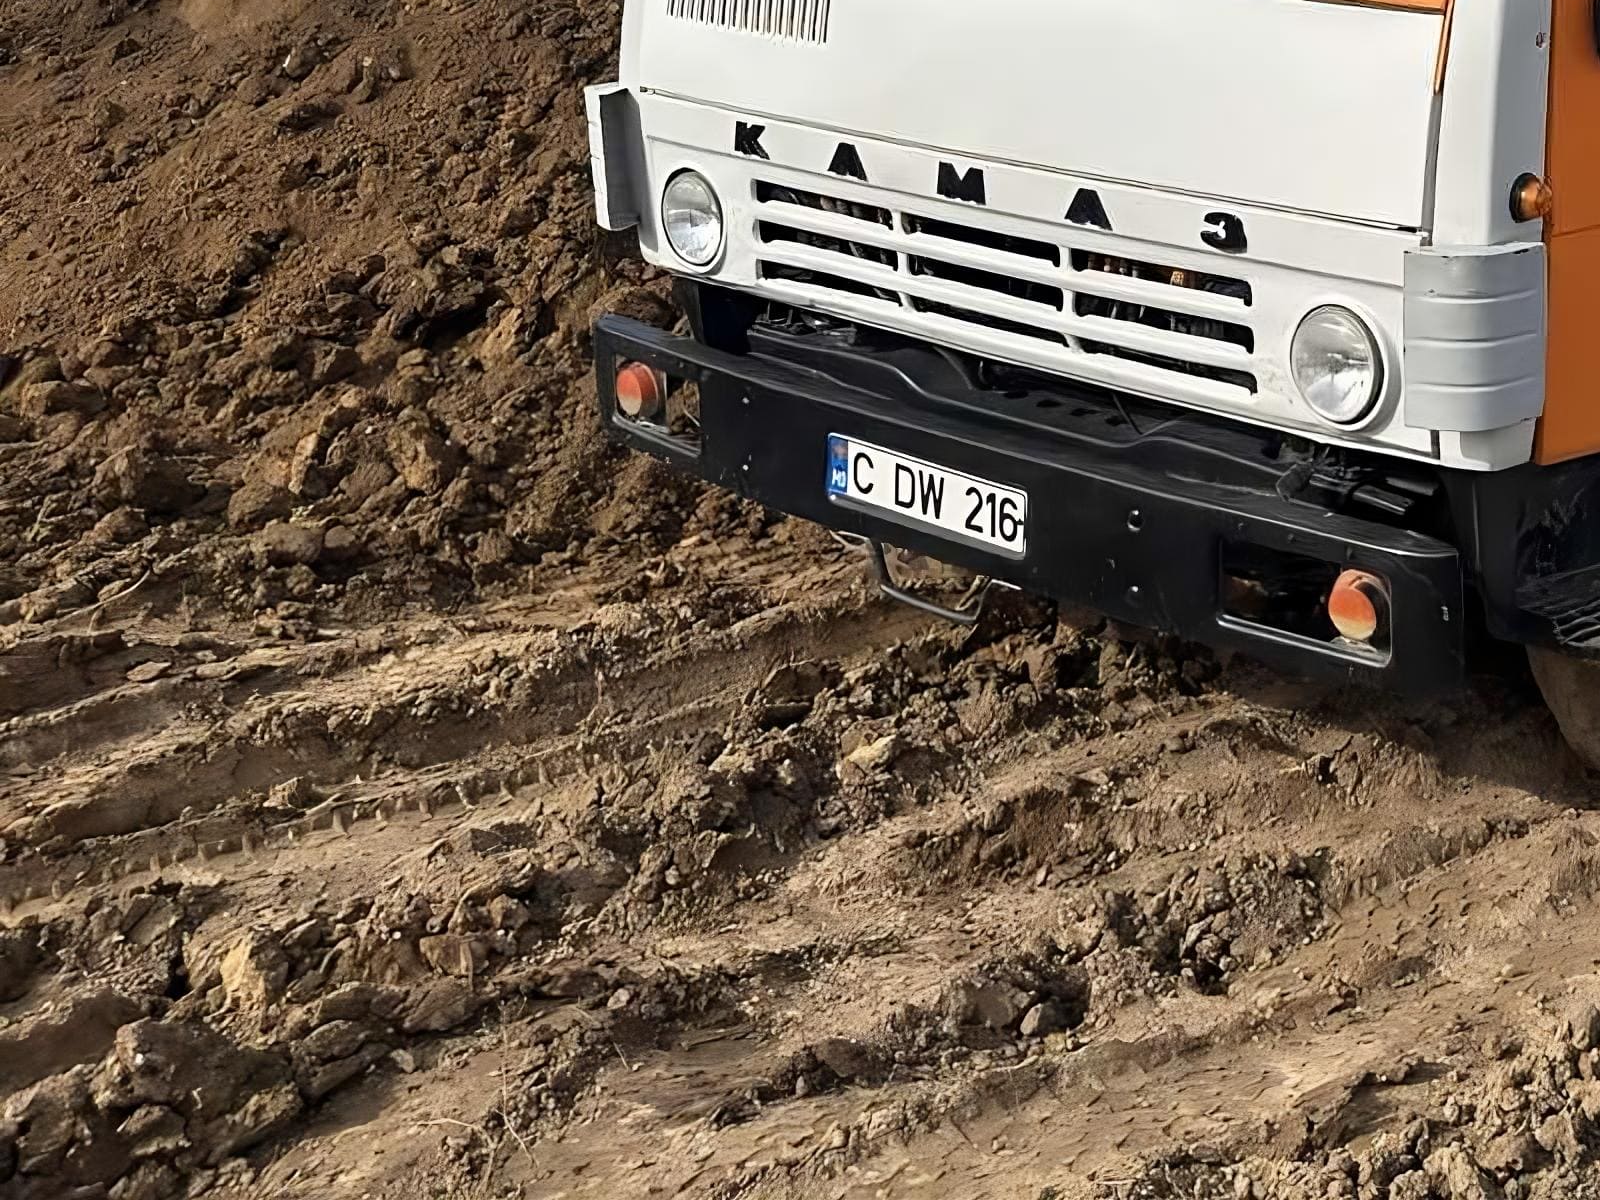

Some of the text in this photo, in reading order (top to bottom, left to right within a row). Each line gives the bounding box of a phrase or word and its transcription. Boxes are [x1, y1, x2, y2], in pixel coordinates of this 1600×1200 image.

[734, 120, 1248, 254] КАМАЗ
[853, 452, 1019, 542] C DW 216
